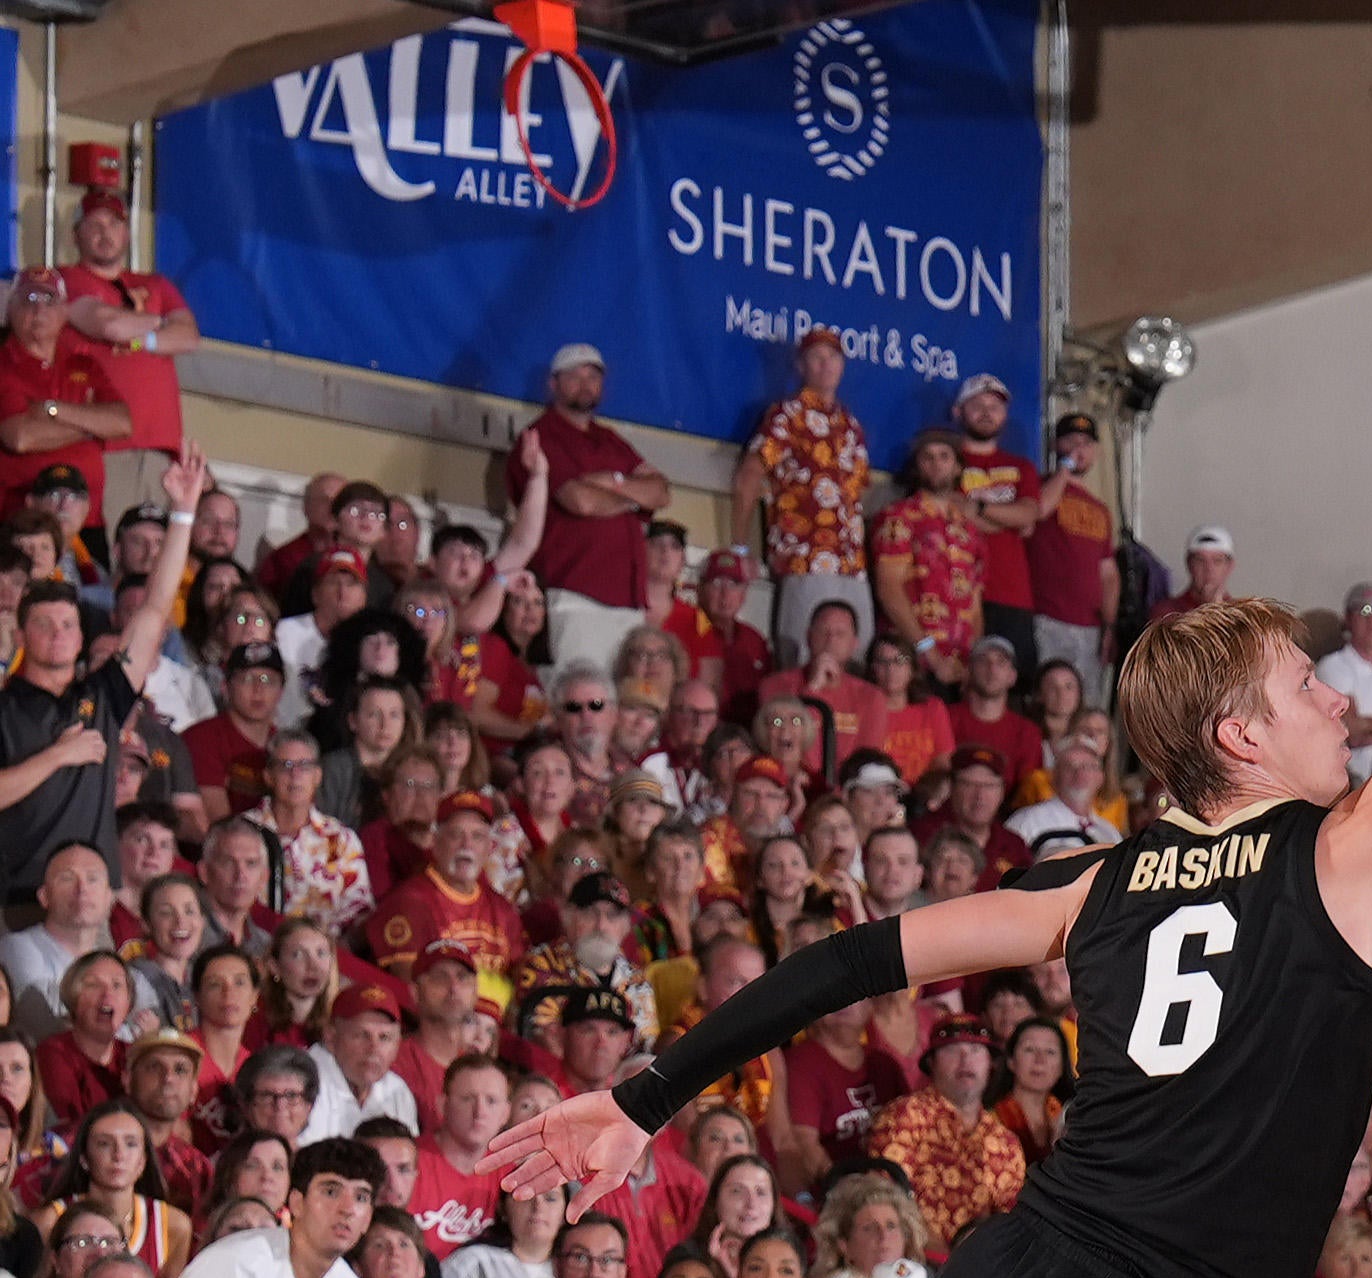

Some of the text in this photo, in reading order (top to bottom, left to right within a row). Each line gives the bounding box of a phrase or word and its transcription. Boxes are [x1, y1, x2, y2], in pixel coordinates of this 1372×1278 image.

[454, 166, 552, 210] ALLEY
[668, 178, 1012, 322] SHERATON
[725, 296, 788, 342] Maui
[884, 329, 906, 369] &
[911, 333, 959, 381] Spa
[1126, 832, 1271, 893] BASKIN
[1126, 901, 1239, 1078] 6
